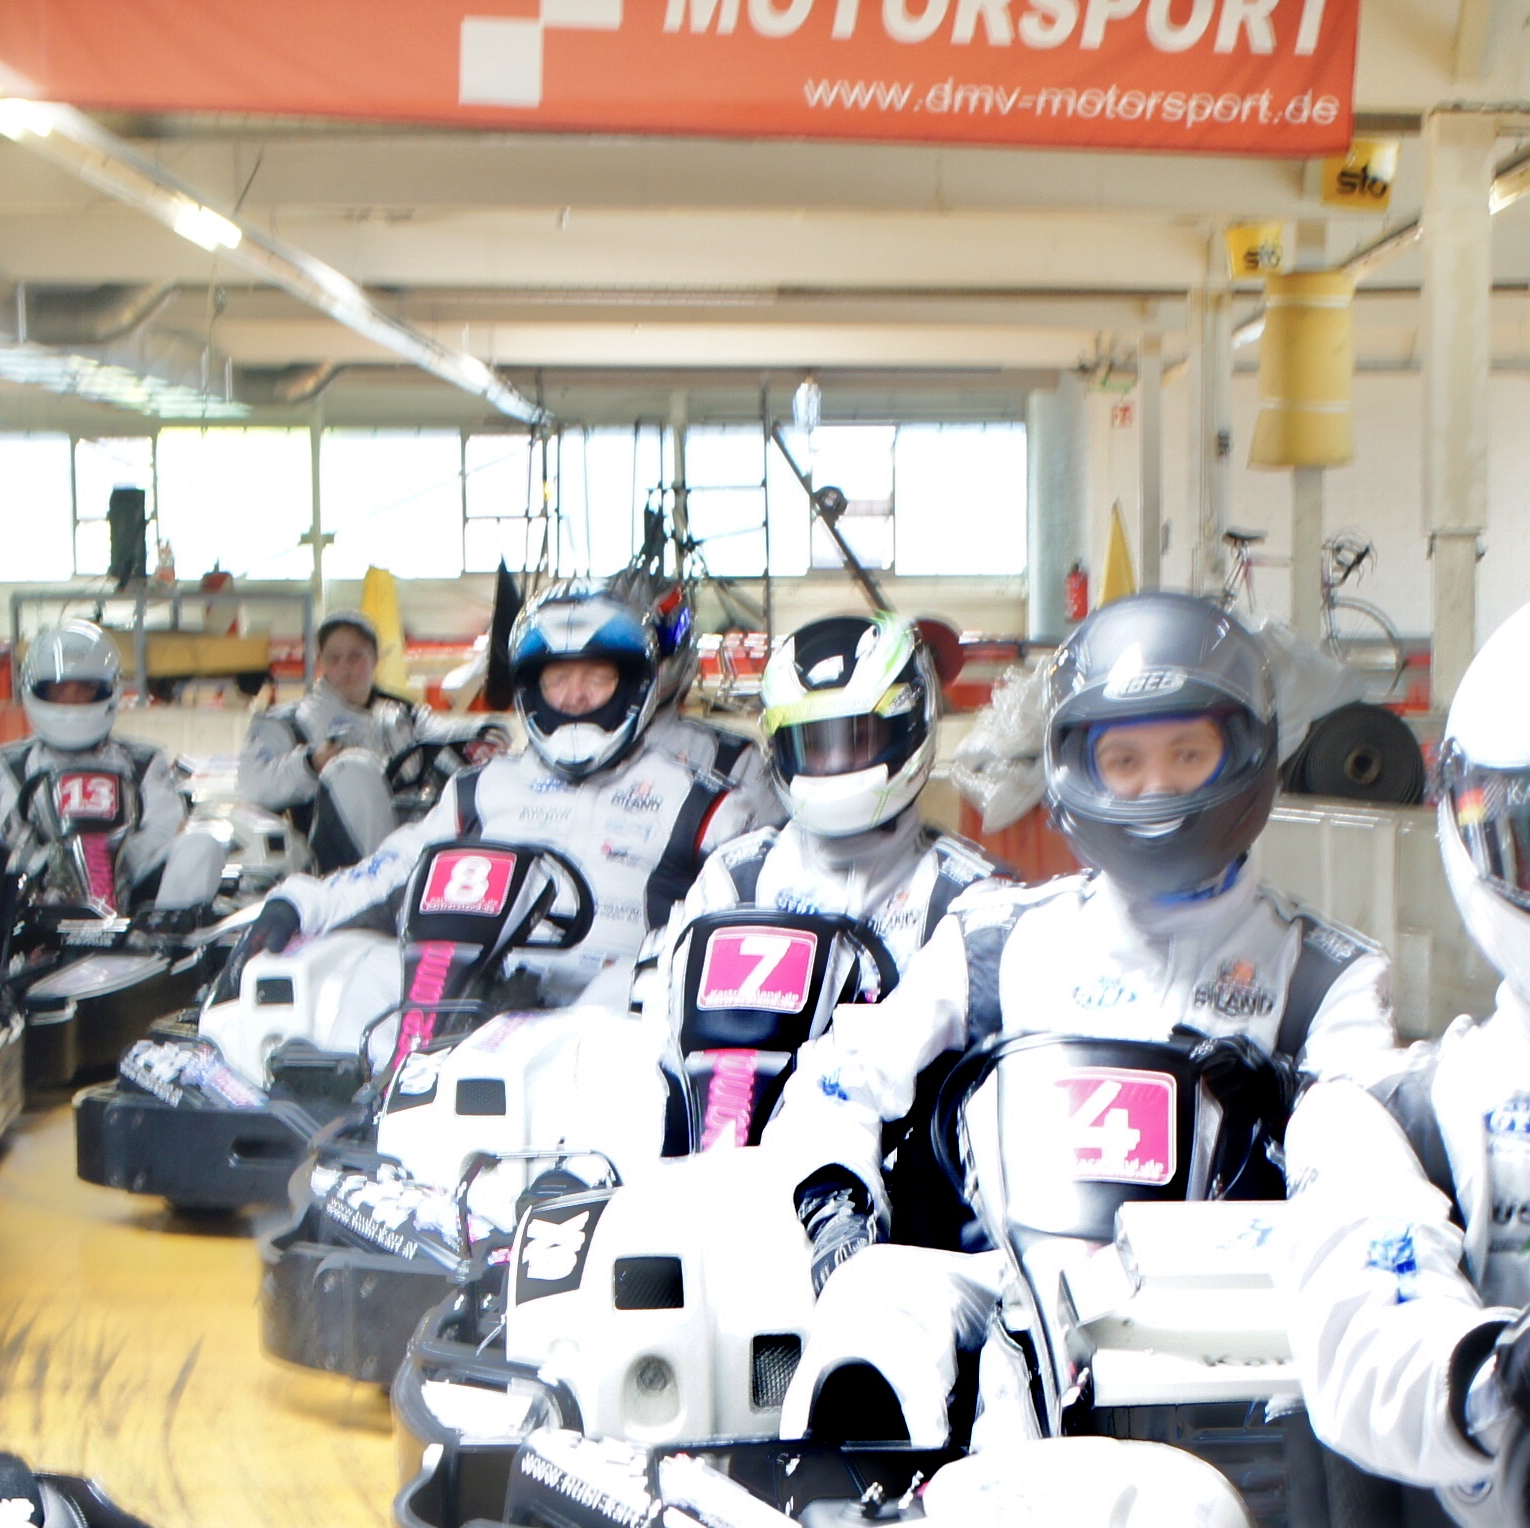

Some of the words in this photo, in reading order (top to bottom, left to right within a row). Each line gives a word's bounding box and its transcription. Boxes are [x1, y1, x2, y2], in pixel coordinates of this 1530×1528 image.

[803, 77, 1340, 126] www.dmv-motorsport.de
[61, 776, 116, 814] 13
[443, 855, 493, 902] 8
[739, 935, 792, 998] 7
[1065, 1080, 1141, 1150] 4
